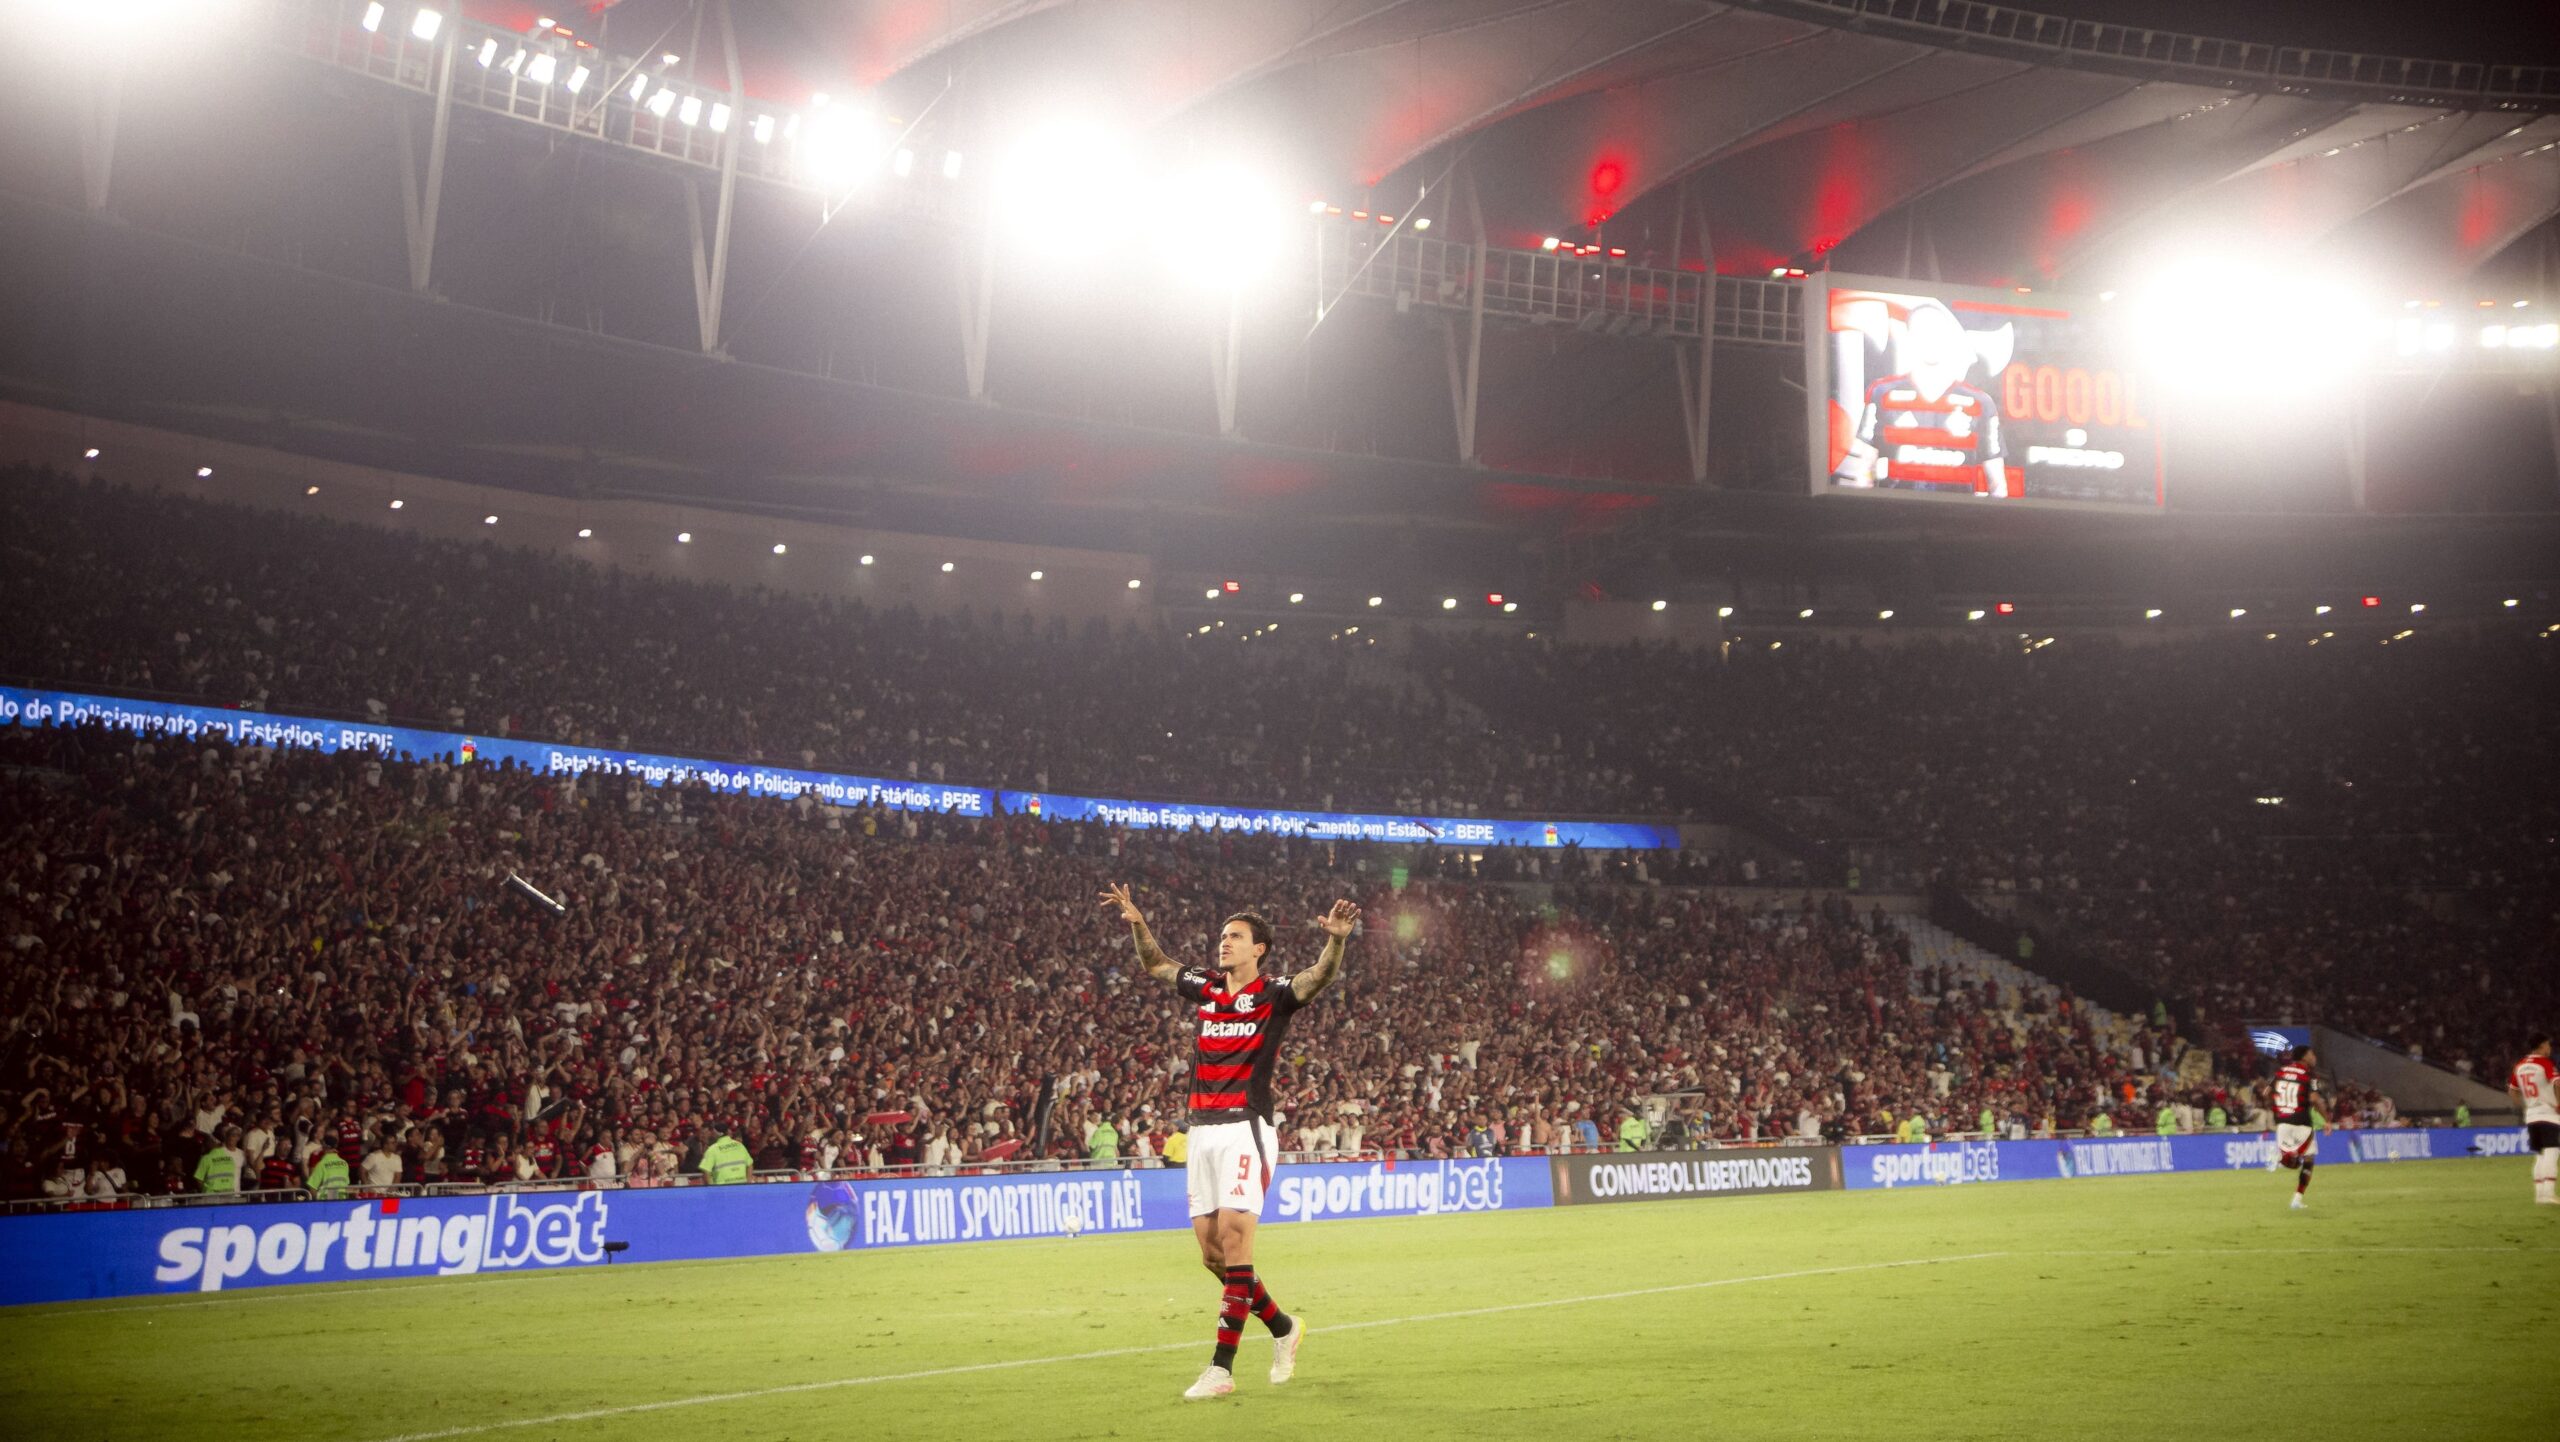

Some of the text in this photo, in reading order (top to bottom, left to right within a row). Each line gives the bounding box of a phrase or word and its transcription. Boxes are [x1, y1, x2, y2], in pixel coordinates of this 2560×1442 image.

[2004, 362, 2148, 428] GOOOL
[26, 698, 53, 719] de
[732, 771, 751, 789] de
[847, 787, 868, 801] em
[942, 791, 980, 811] BEPE
[1364, 824, 1384, 836] em
[1457, 824, 1494, 840] BEPE
[1202, 1020, 1257, 1037] Betano
[2275, 1080, 2301, 1108] 50
[2520, 1072, 2539, 1098] 15
[1237, 1154, 1251, 1180] 9
[1590, 1156, 1812, 1197] CONMEBOL LIBERTADORES
[1872, 1140, 1999, 1188] sportingbet
[1278, 1158, 1503, 1222] sportingbet
[863, 1190, 909, 1244] FAZ
[960, 1180, 1105, 1239] SPORTINGBET
[155, 1191, 608, 1292] sportingbet
